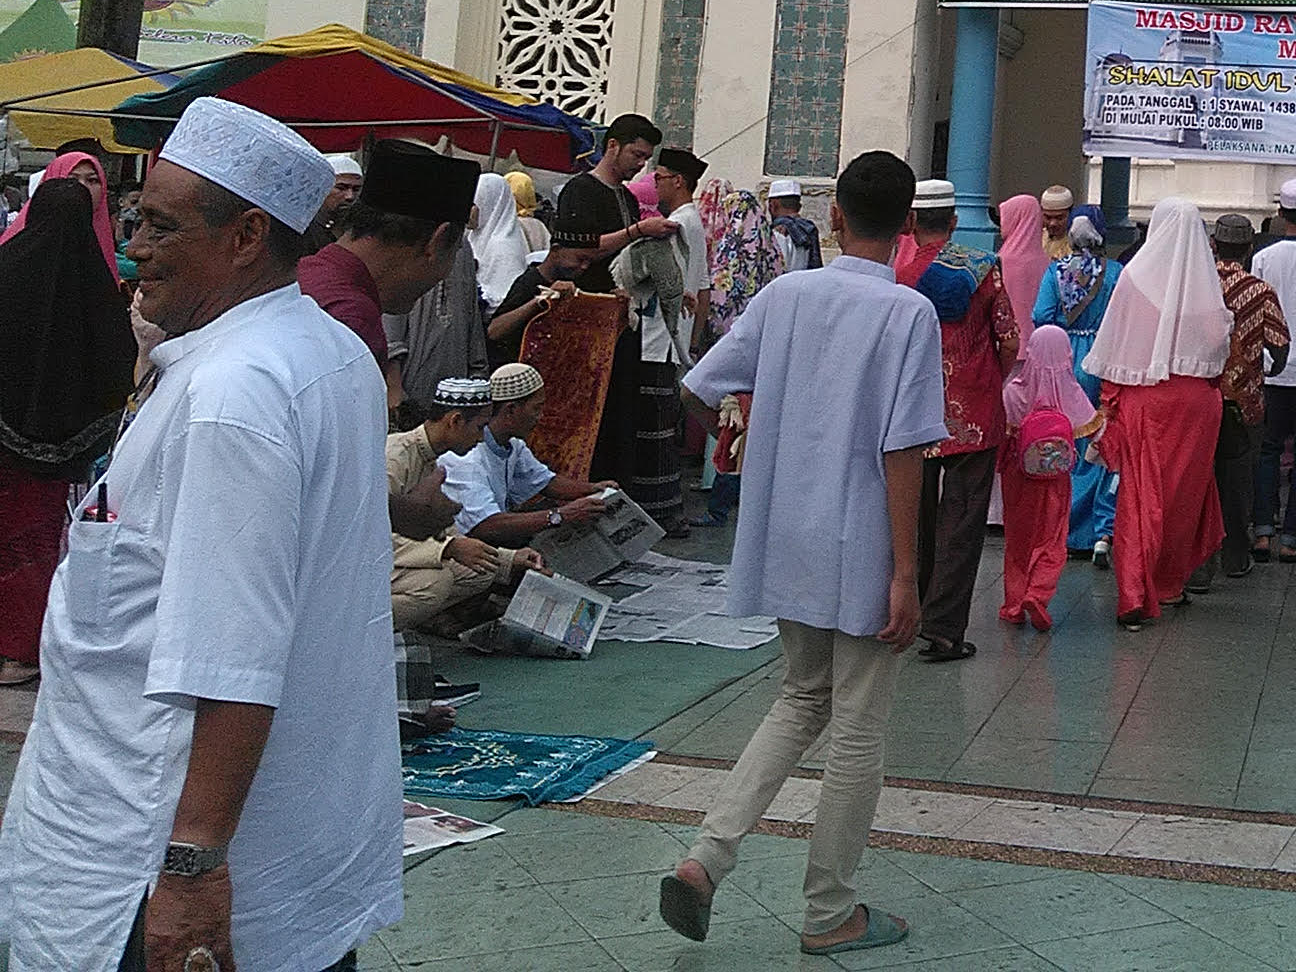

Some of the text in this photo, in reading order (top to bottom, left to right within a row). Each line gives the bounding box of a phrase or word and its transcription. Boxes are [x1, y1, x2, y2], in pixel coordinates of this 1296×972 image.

[1136, 9, 1245, 33] MASJID
[1108, 65, 1220, 89] SHALAT
[1225, 70, 1290, 94] IDUL
[1106, 94, 1135, 107] PADA
[1139, 96, 1193, 109] TANGGAL
[1209, 98, 1215, 110] 1
[1219, 99, 1266, 112] SYAWAL
[1269, 102, 1296, 114] 1438
[1105, 112, 1117, 124] DI
[1120, 113, 1156, 125] MULAI
[1159, 114, 1198, 127] PUKUL
[1241, 118, 1264, 130] WIB
[1207, 141, 1266, 153] PELAKSANA
